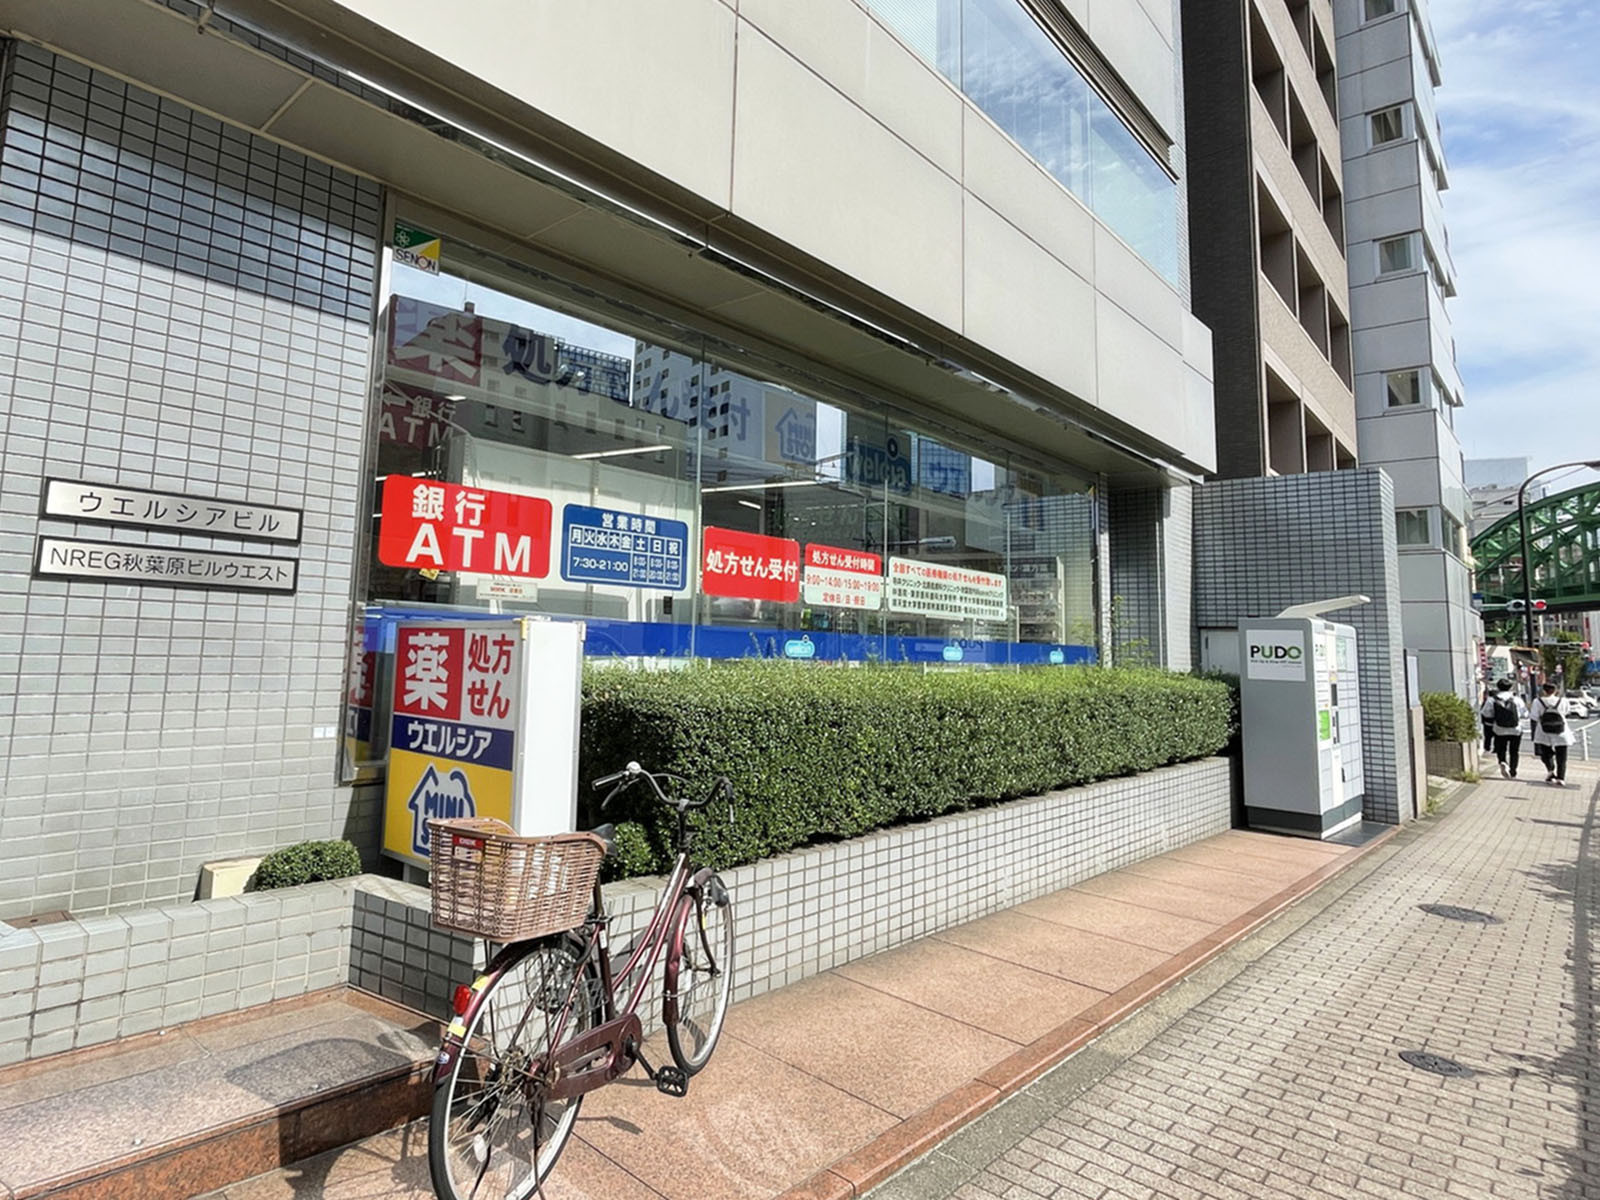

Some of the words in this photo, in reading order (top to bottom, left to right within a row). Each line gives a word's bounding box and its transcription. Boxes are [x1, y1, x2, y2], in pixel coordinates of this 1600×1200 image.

[396, 249, 436, 271] SENON
[79, 492, 280, 533] ウエルシアビル
[412, 484, 485, 527] 銀行
[602, 512, 657, 535] 営業時間
[50, 547, 288, 583] NREG秋葉原ビルウエスト
[406, 523, 532, 573] ATM
[572, 556, 629, 572] 7:30-21:00
[706, 549, 798, 583] 処方せん受付
[467, 633, 515, 675] 処方
[1250, 645, 1302, 660] PUDO
[403, 632, 450, 711] 薬
[467, 679, 511, 719] せん
[407, 721, 492, 759] ウエルシア
[425, 789, 465, 819] MINI
